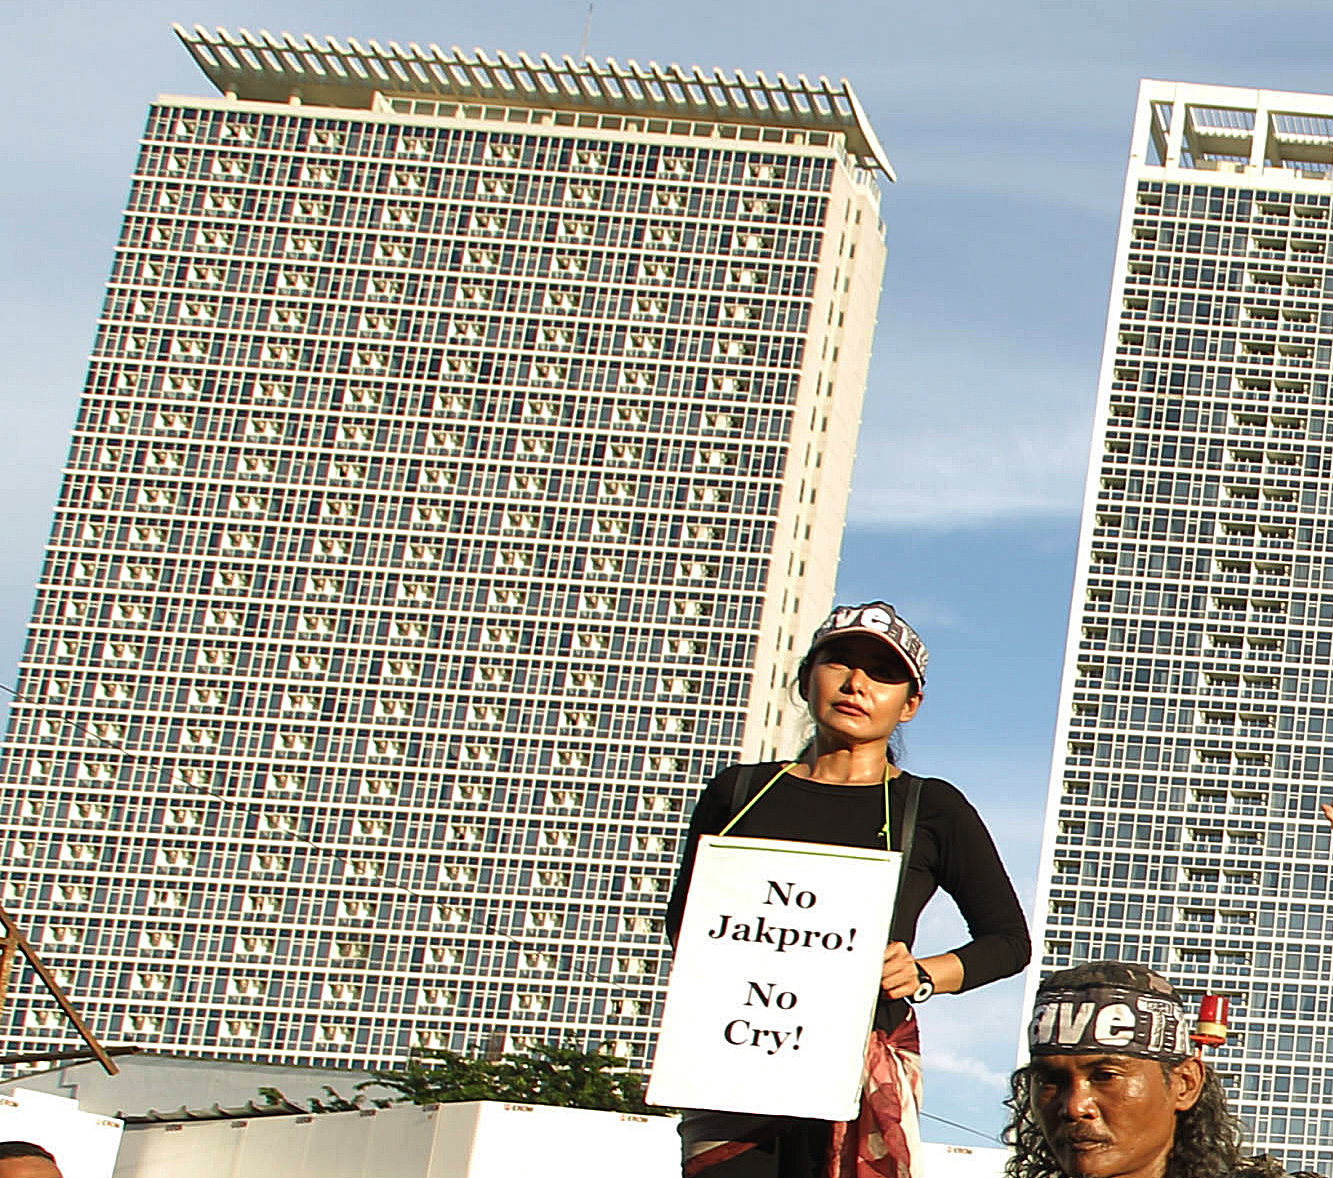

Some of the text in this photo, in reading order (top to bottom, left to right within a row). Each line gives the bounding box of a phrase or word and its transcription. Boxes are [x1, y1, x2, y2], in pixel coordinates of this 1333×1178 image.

[763, 880, 817, 909] No
[708, 915, 857, 952] Jakpro!
[744, 981, 798, 1010] No
[724, 1019, 804, 1055] Cry!
